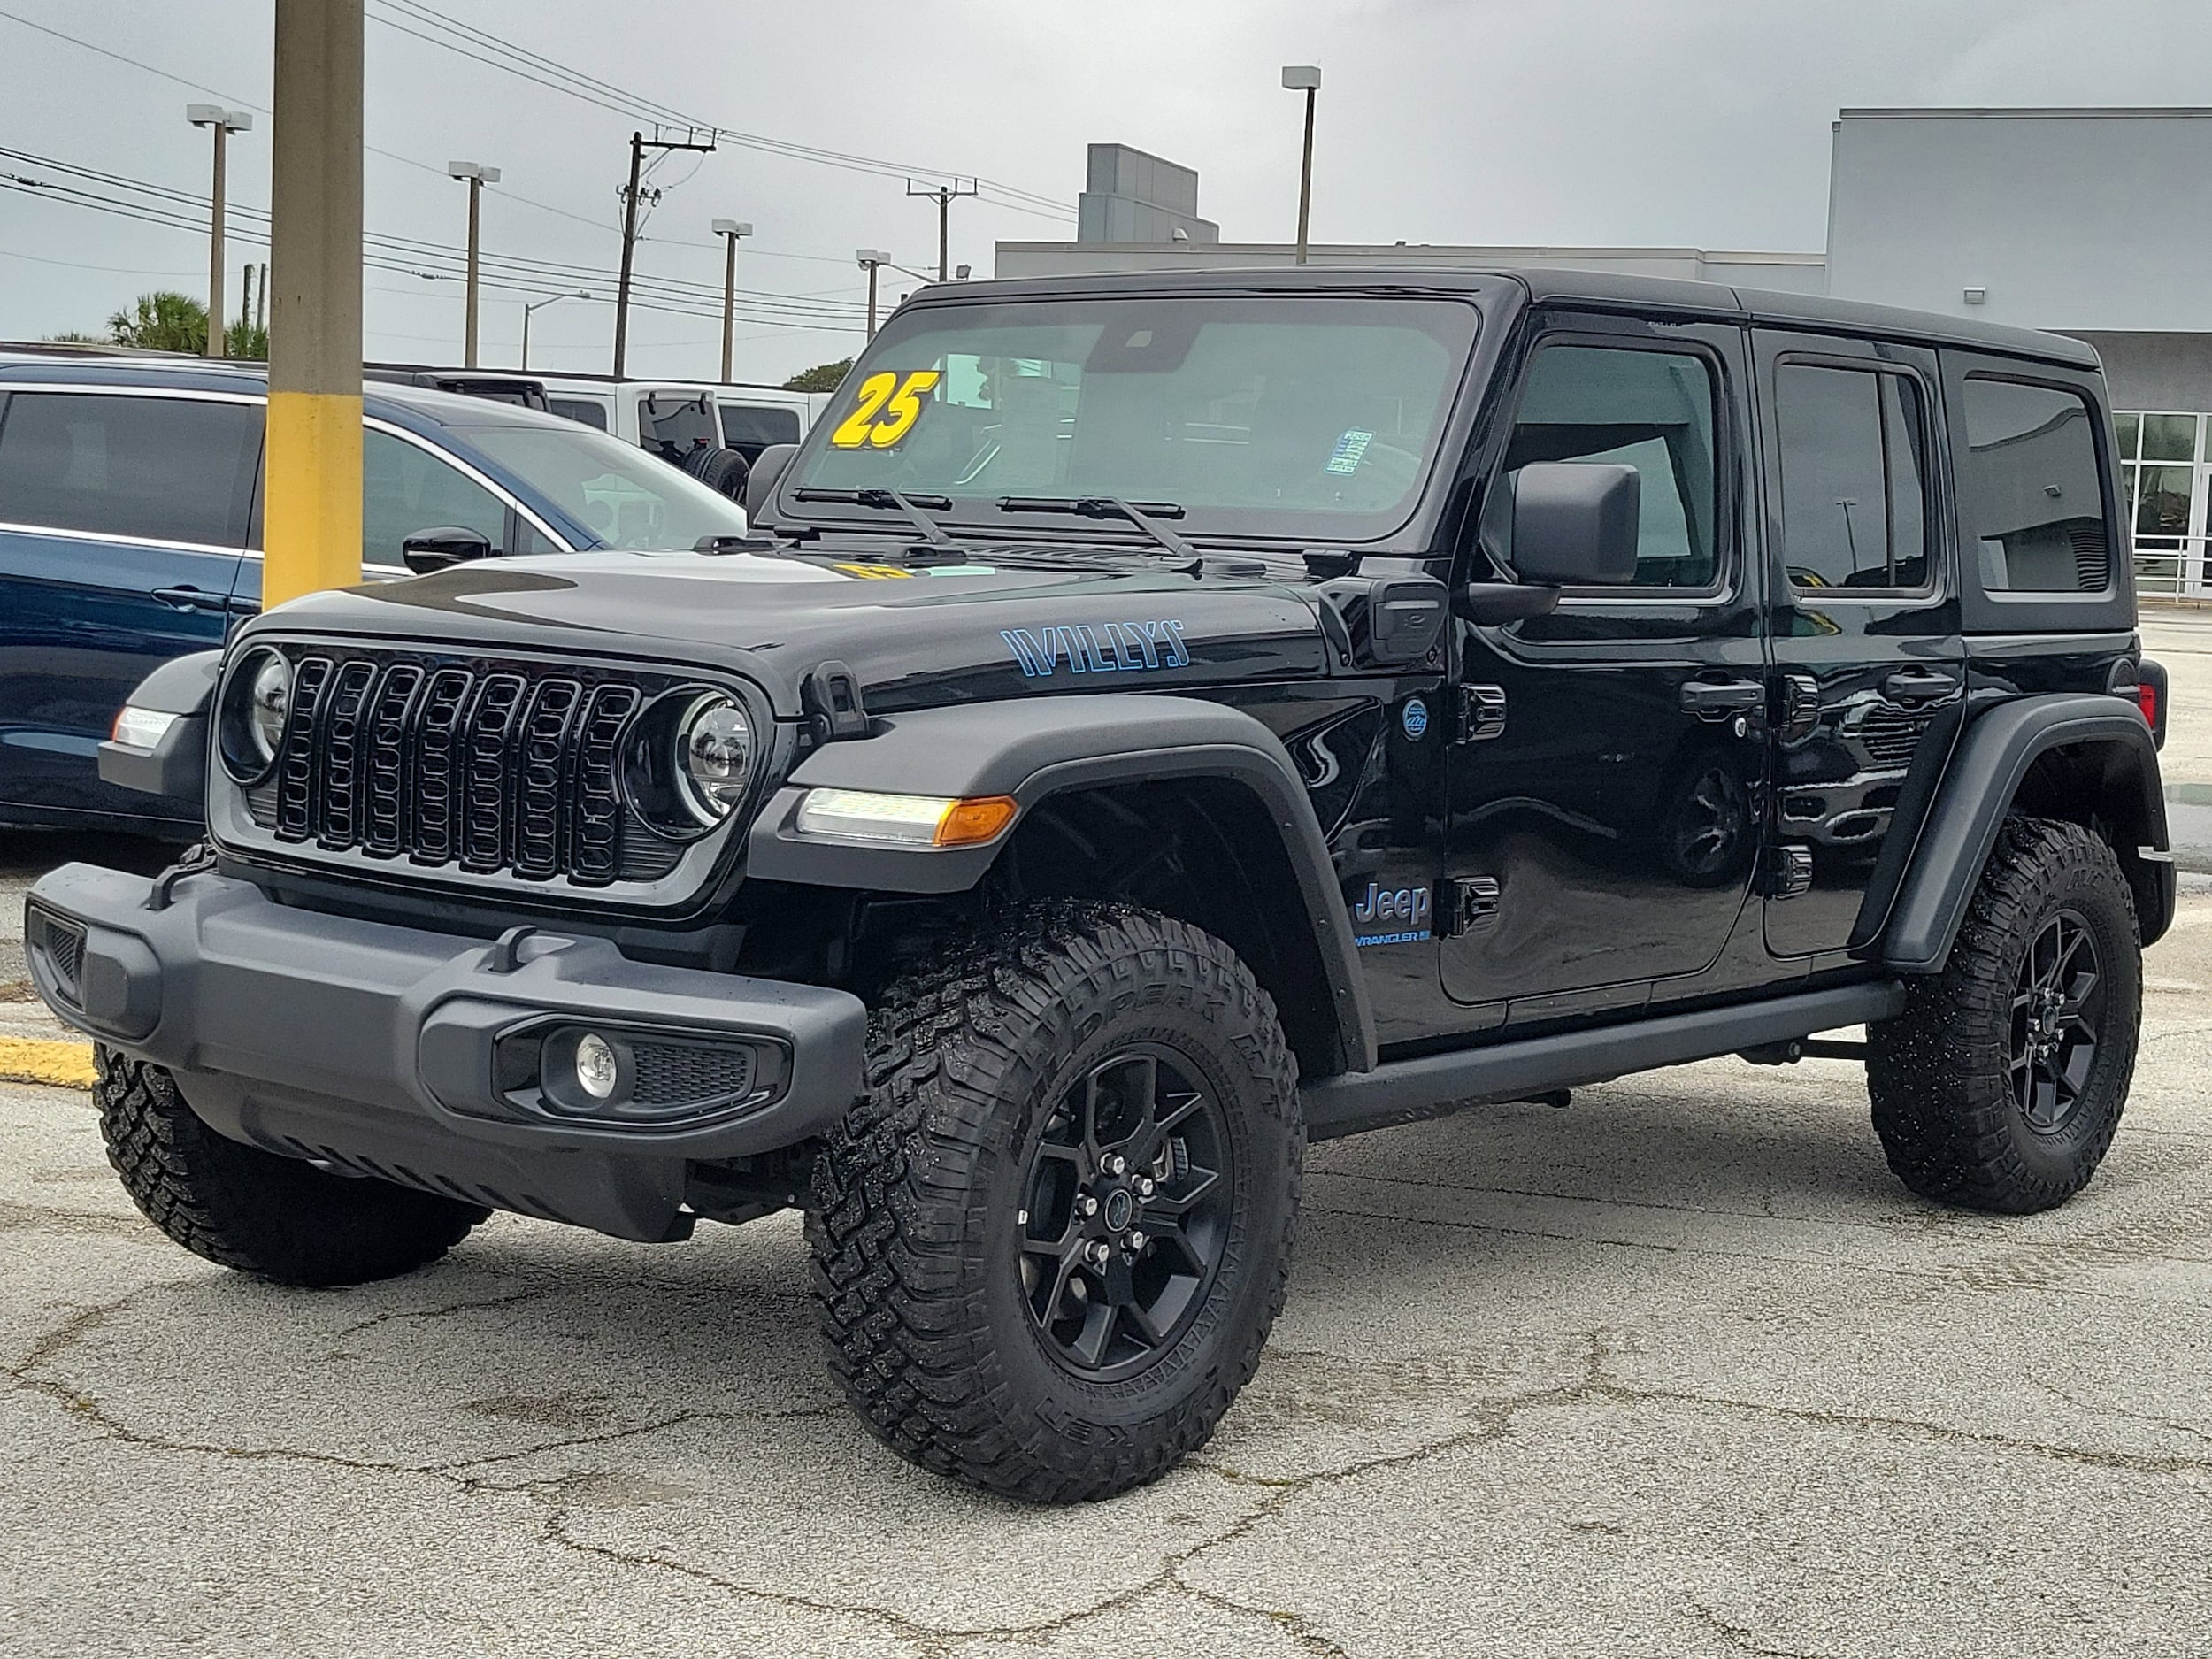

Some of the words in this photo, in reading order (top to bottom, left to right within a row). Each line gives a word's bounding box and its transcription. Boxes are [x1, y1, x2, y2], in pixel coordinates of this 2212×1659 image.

[832, 371, 940, 449] 25
[1000, 619, 1190, 677] WILLYS
[1355, 882, 1430, 926] Jeep
